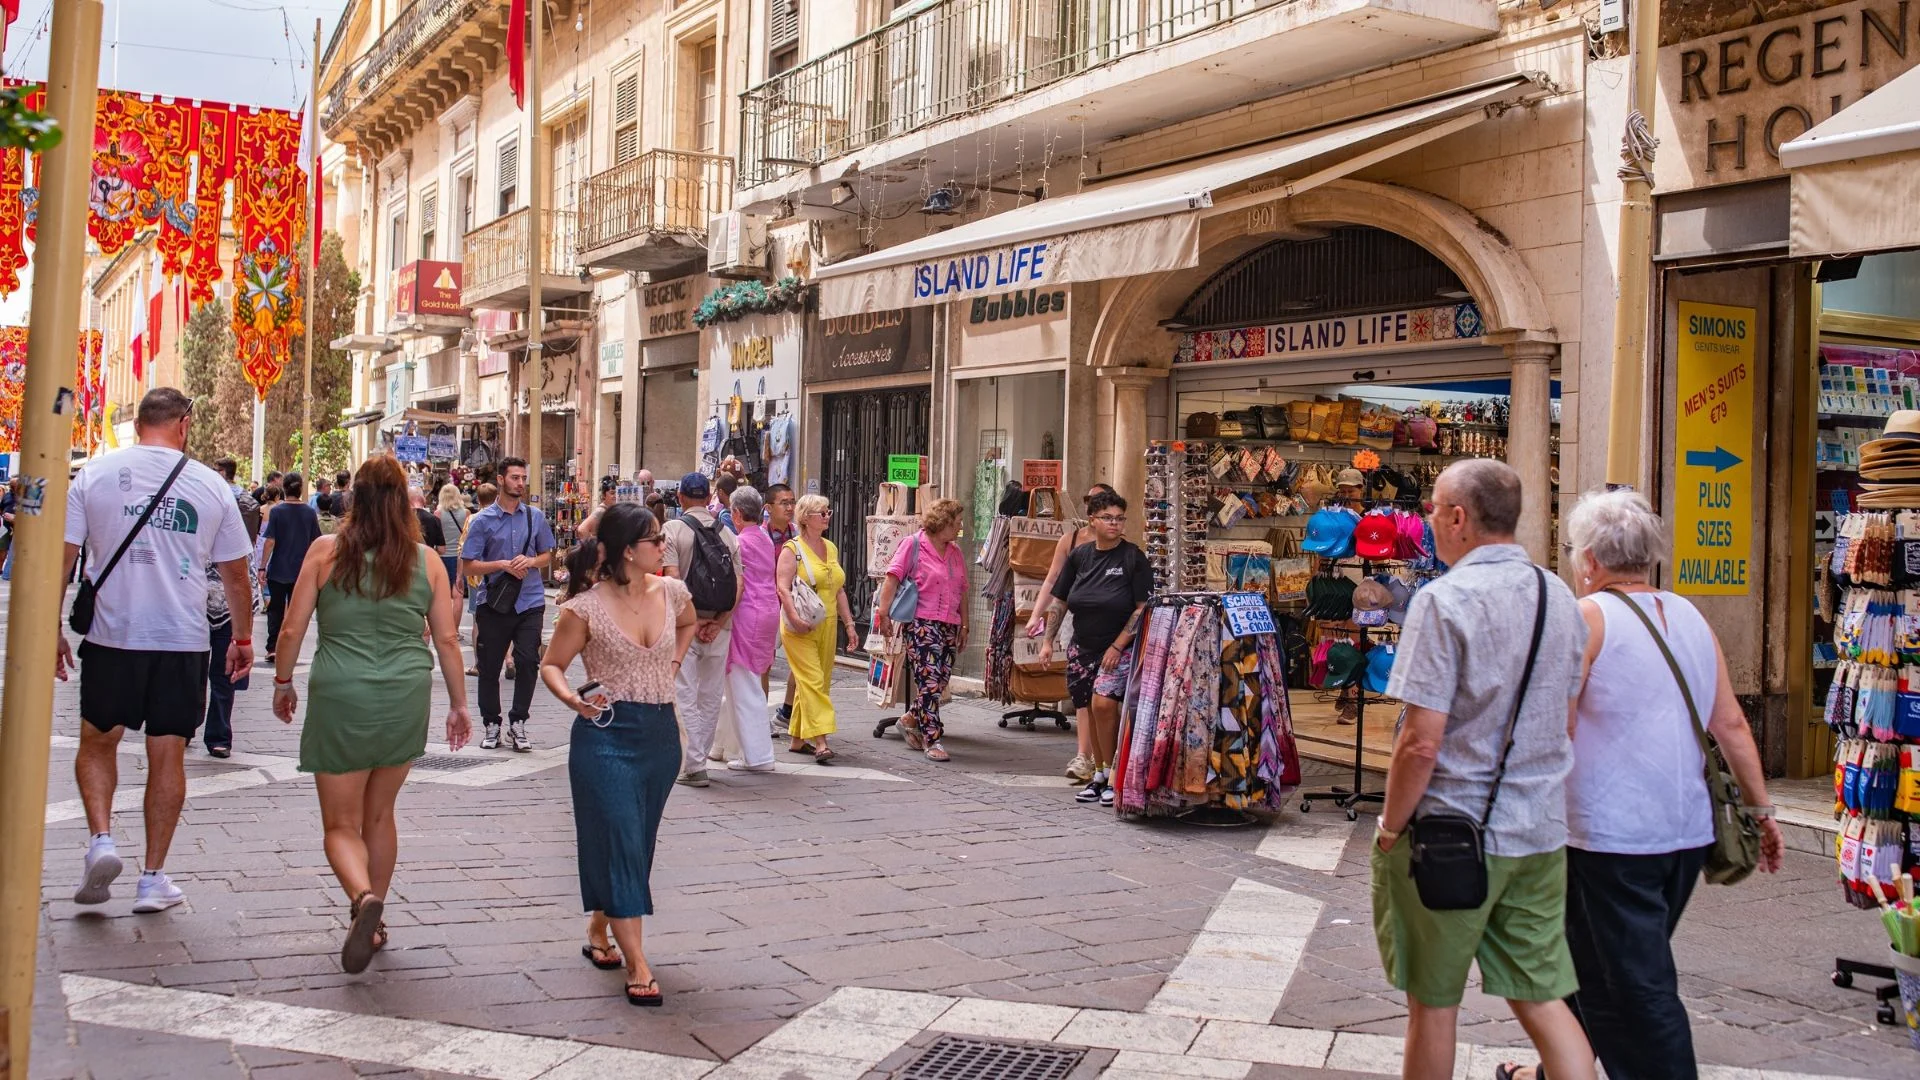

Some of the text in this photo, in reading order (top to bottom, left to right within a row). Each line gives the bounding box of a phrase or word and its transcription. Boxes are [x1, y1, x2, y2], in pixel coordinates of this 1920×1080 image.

[1679, 3, 1920, 103] REGEN
[1247, 207, 1275, 229] 1901
[914, 243, 1047, 298] ISLAND LIFE
[421, 300, 440, 309] Gold
[439, 291, 451, 299] The
[970, 288, 1066, 324] Bubbles
[649, 310, 686, 335] HOUSE
[1267, 314, 1408, 354] ISLAND LIFE
[1688, 315, 1746, 340] SIMONS
[832, 341, 893, 368] Accessories
[1694, 341, 1740, 354] GENTS WEAR
[1684, 362, 1747, 418] MEN'S SUITS
[1710, 401, 1728, 425] €79
[893, 468, 916, 480] €3.50
[1027, 475, 1056, 486] €9.99
[1699, 482, 1732, 509] PLUS
[124, 504, 174, 520] NOTH
[1017, 521, 1065, 536] MALTA
[1696, 520, 1733, 547] SIZES
[1678, 559, 1746, 585] AVAILABLE
[1226, 595, 1264, 608] SCARVES
[1231, 613, 1239, 623] 1
[1246, 611, 1269, 621] €4.95
[1234, 623, 1243, 634] 3
[1249, 622, 1273, 632] €10.00
